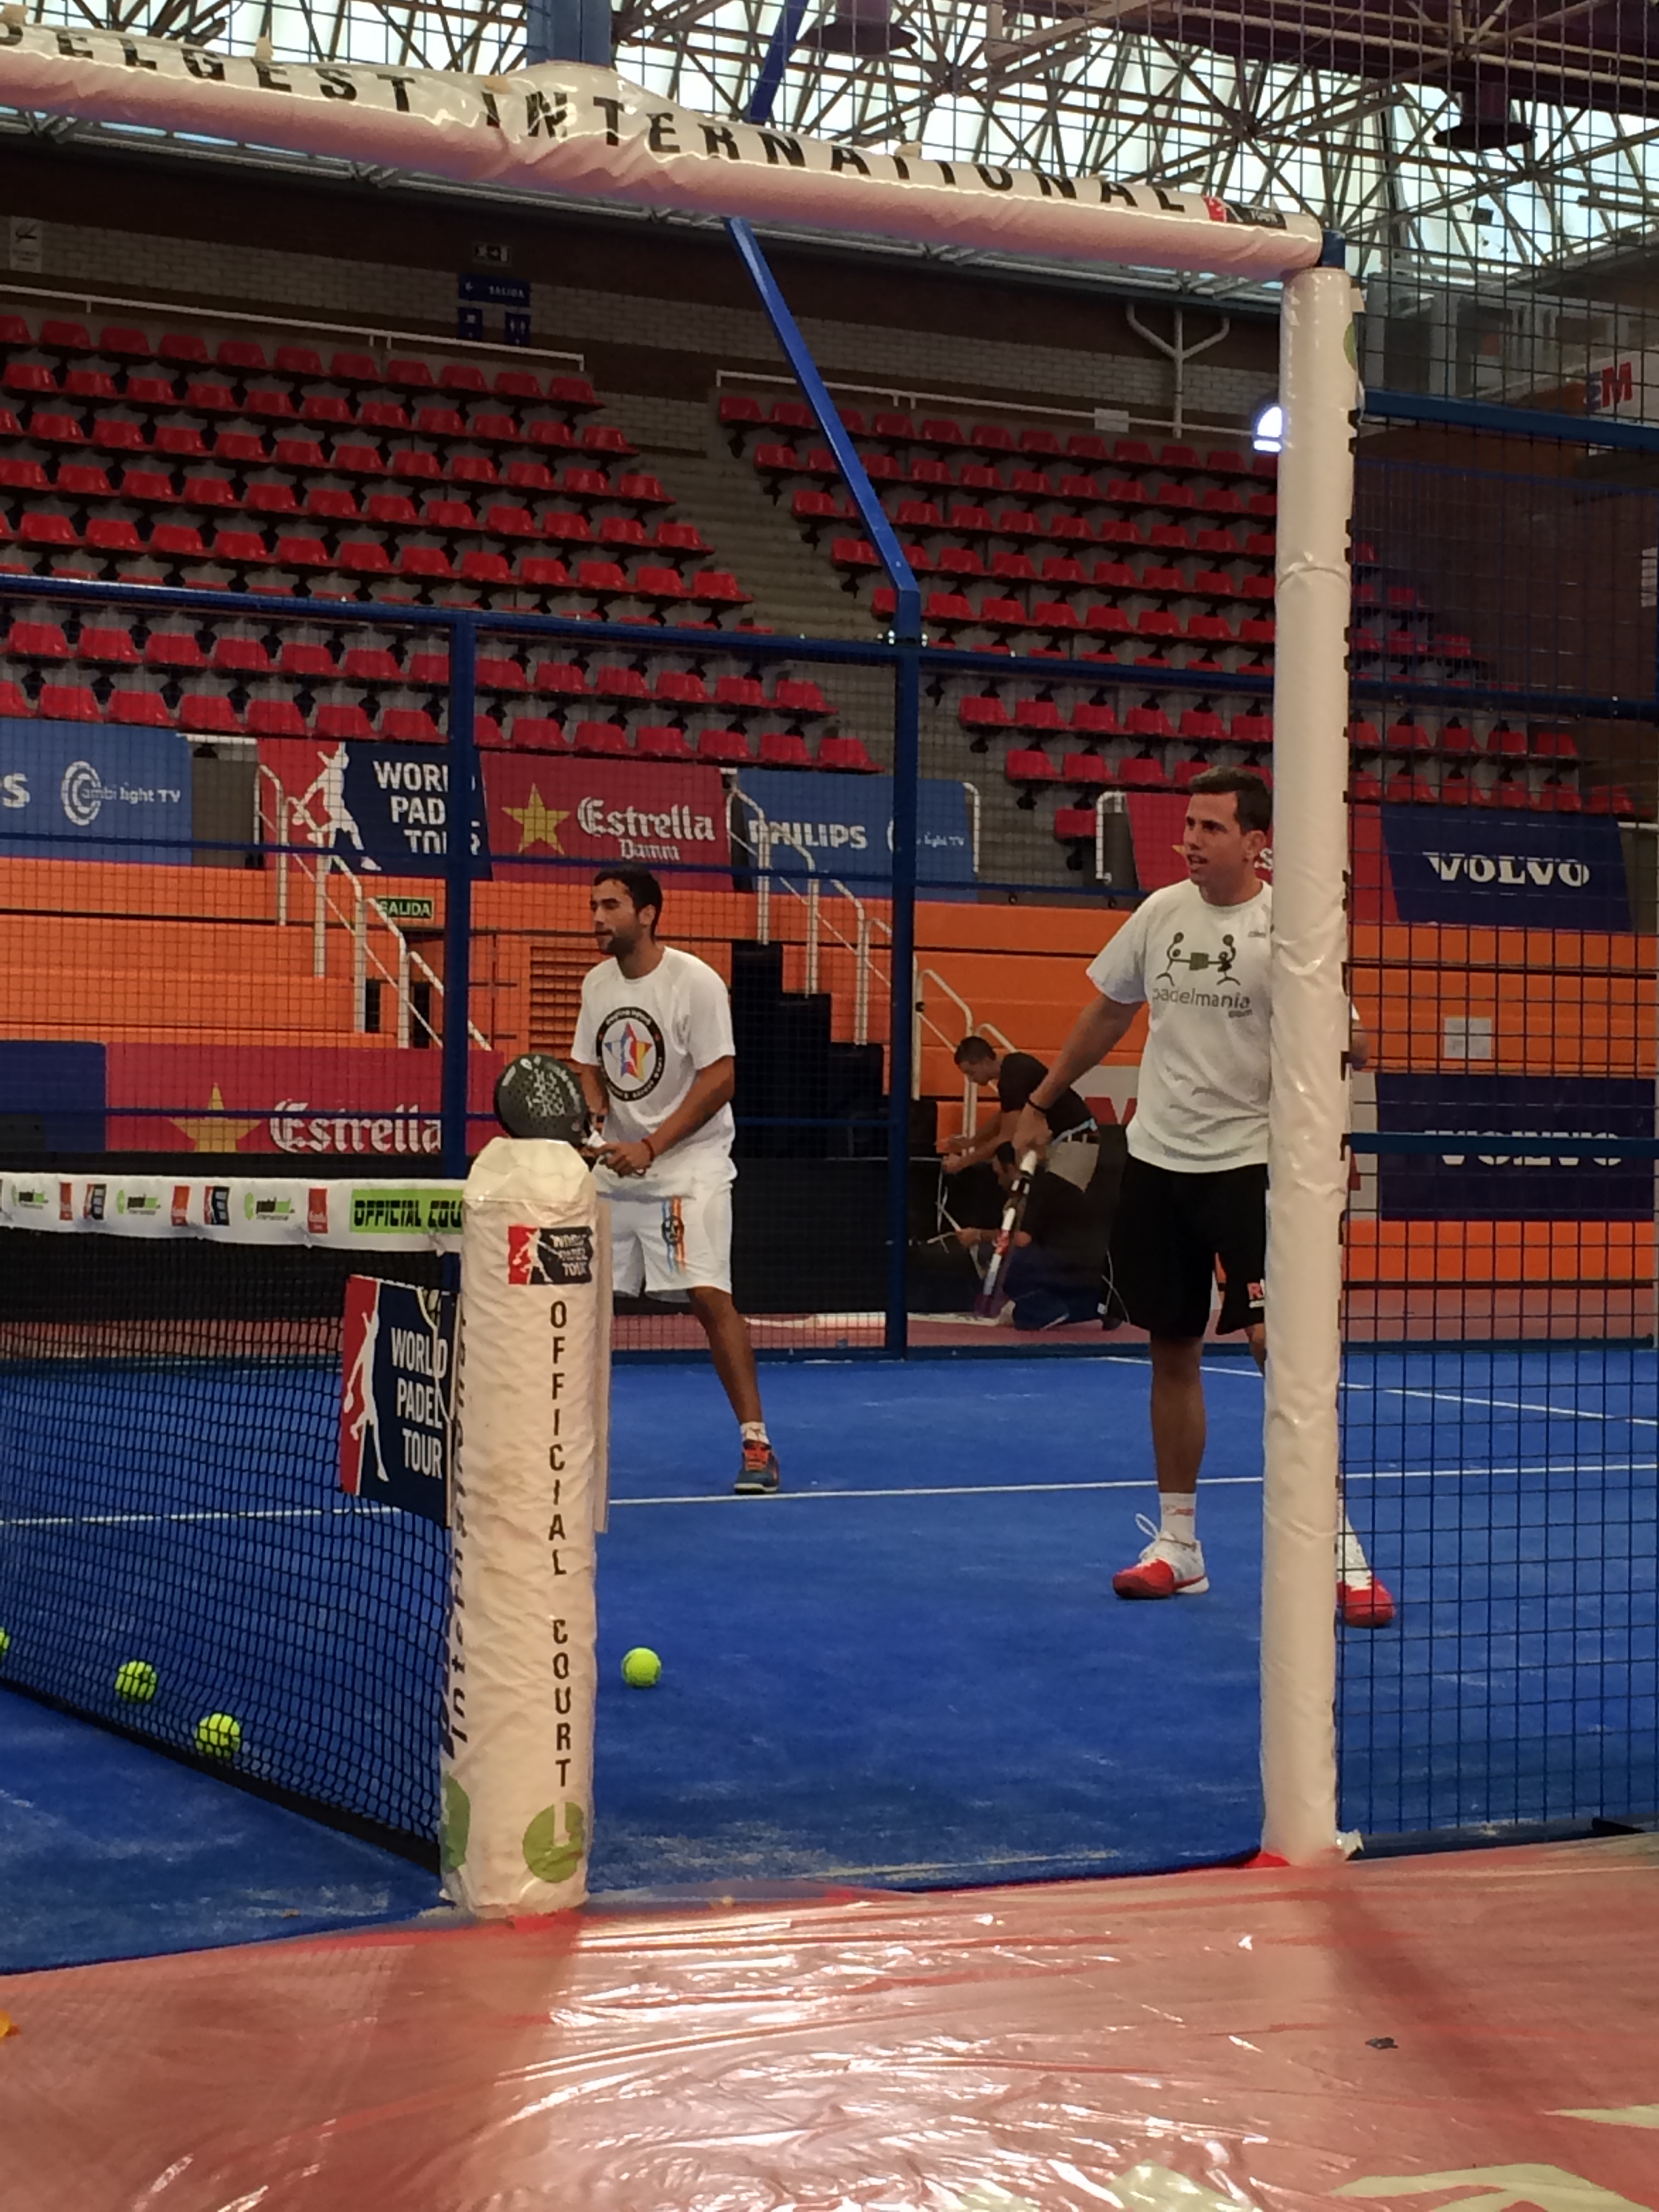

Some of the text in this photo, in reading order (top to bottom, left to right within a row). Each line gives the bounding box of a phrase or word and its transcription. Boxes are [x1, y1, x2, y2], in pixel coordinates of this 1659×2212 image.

[489, 285, 525, 299] SALIDA
[157, 790, 181, 803] TV
[577, 796, 716, 841] Estrella
[618, 838, 680, 861] Damm
[1422, 851, 1590, 887] VOLVO
[354, 1200, 422, 1227] OFFICIAL
[390, 1327, 449, 1380] WORLD
[396, 1376, 443, 1430] PADEL
[402, 1427, 443, 1480] TOUR
[548, 1300, 571, 1788] OFFICIAL COURT
